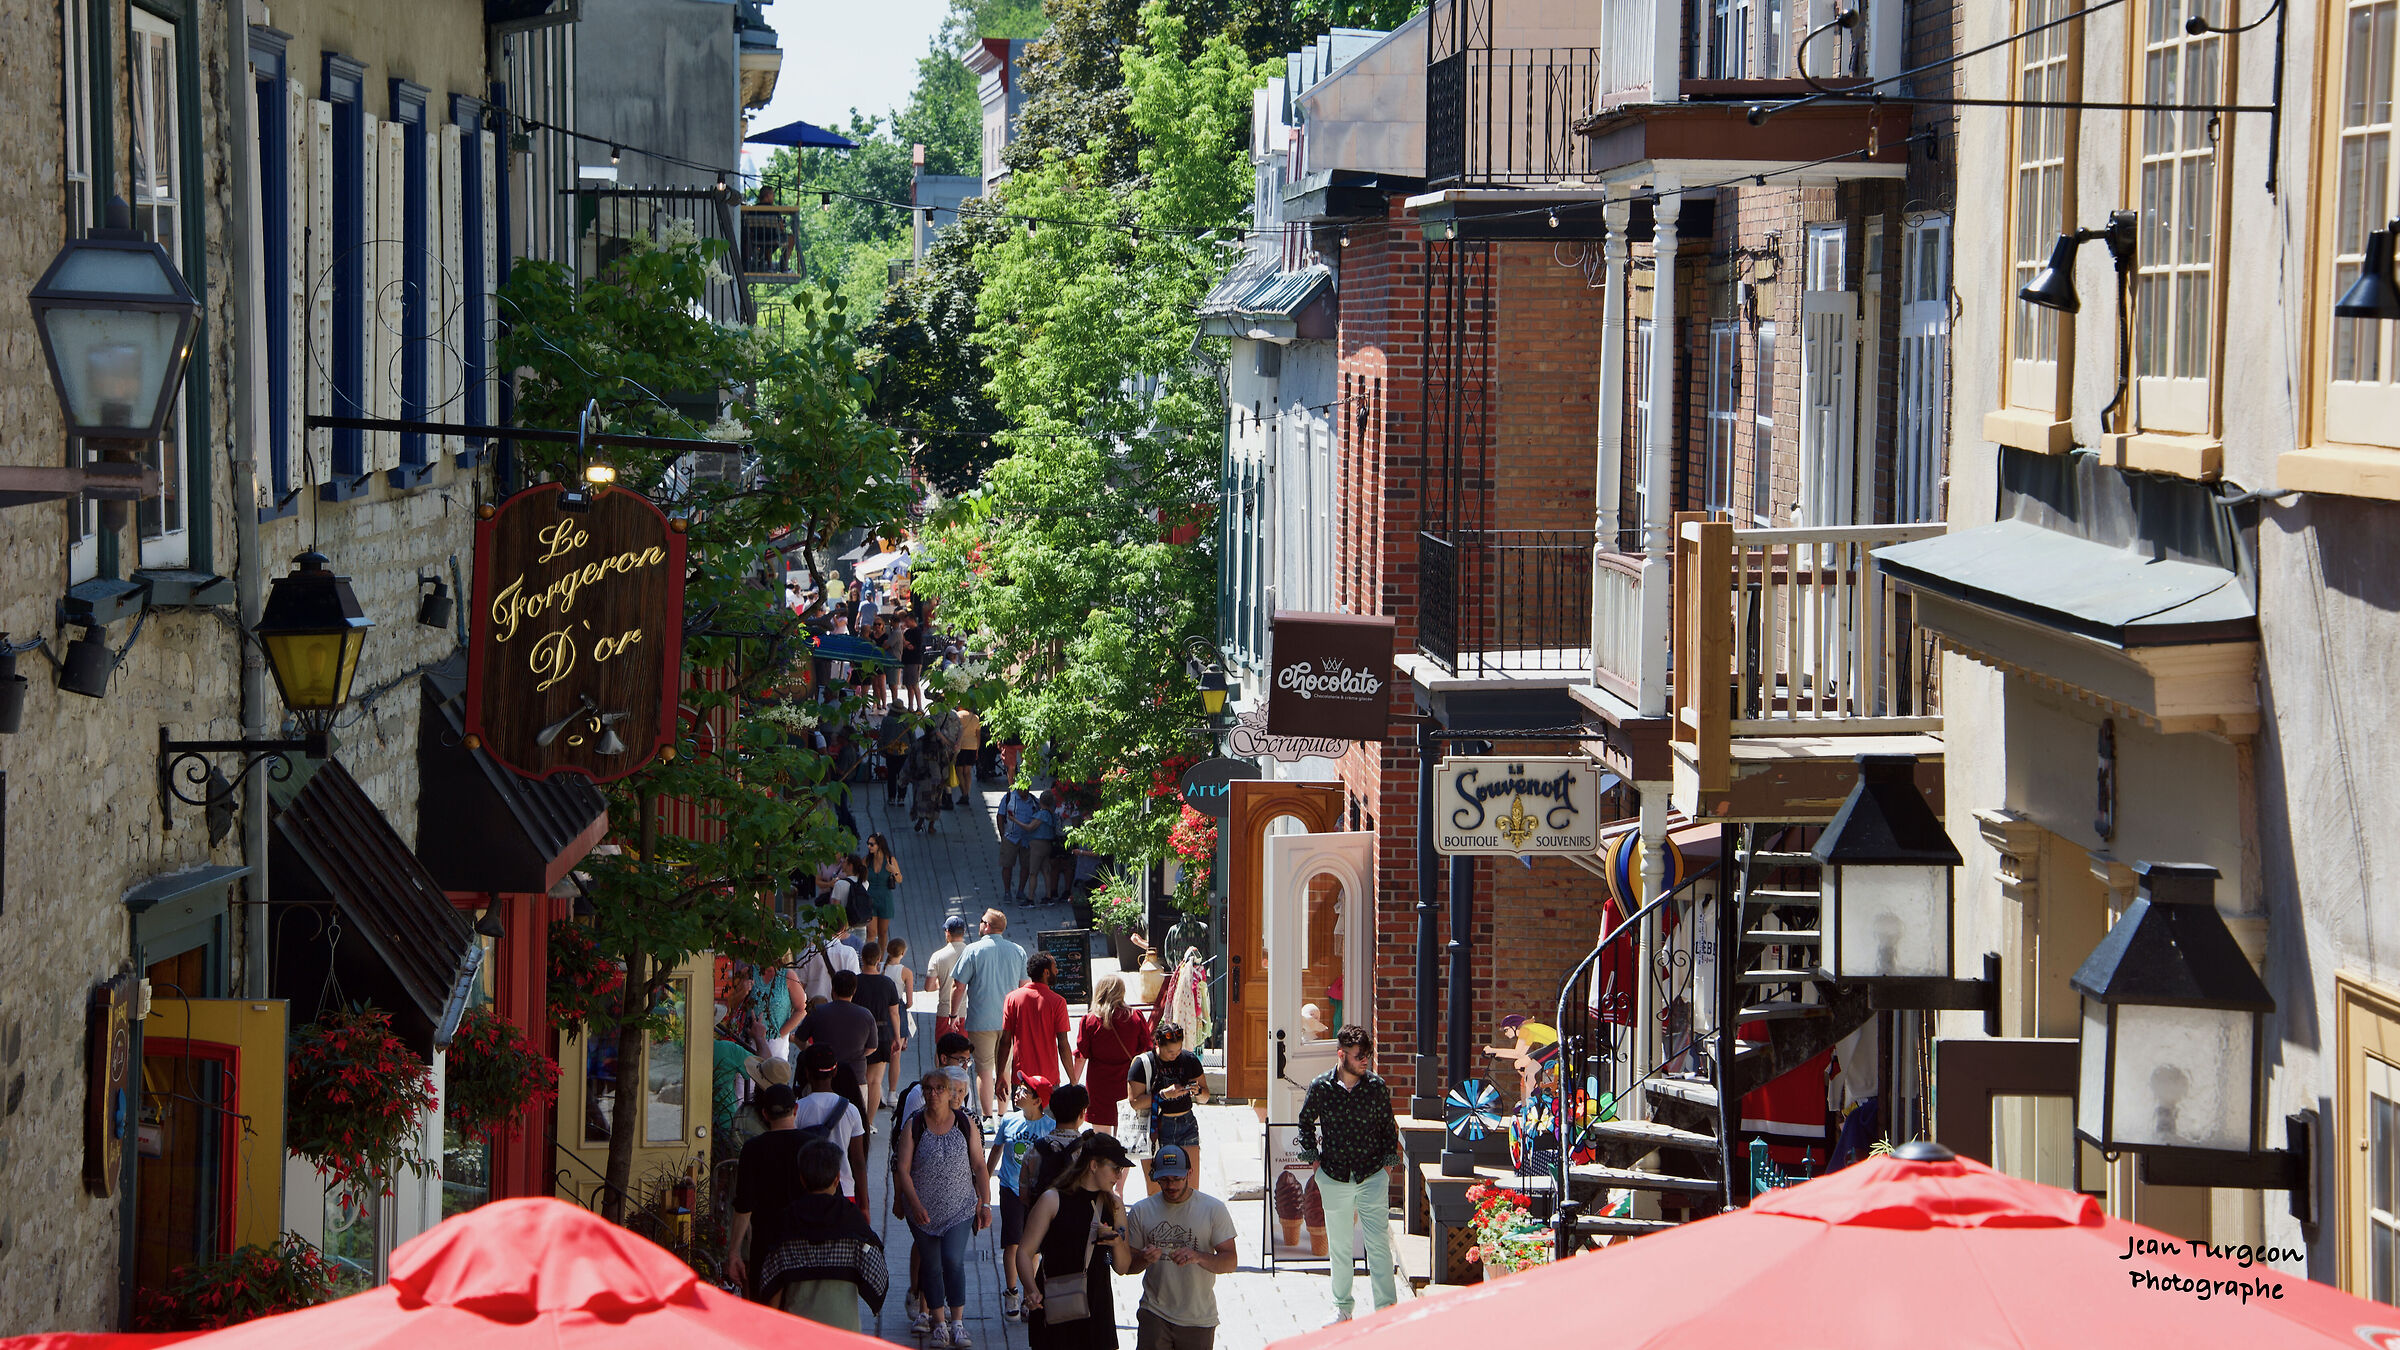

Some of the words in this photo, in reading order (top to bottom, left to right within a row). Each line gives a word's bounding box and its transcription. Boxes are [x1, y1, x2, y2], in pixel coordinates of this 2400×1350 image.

[538, 517, 589, 564] Le
[492, 545, 666, 642] Forgeron
[1277, 661, 1383, 700] Chocolato
[1233, 729, 1344, 760] Scrupules
[1508, 763, 1524, 775] LE
[1444, 836, 1498, 847] BOUTIQUE
[1536, 836, 1591, 847] SOUVENIRS
